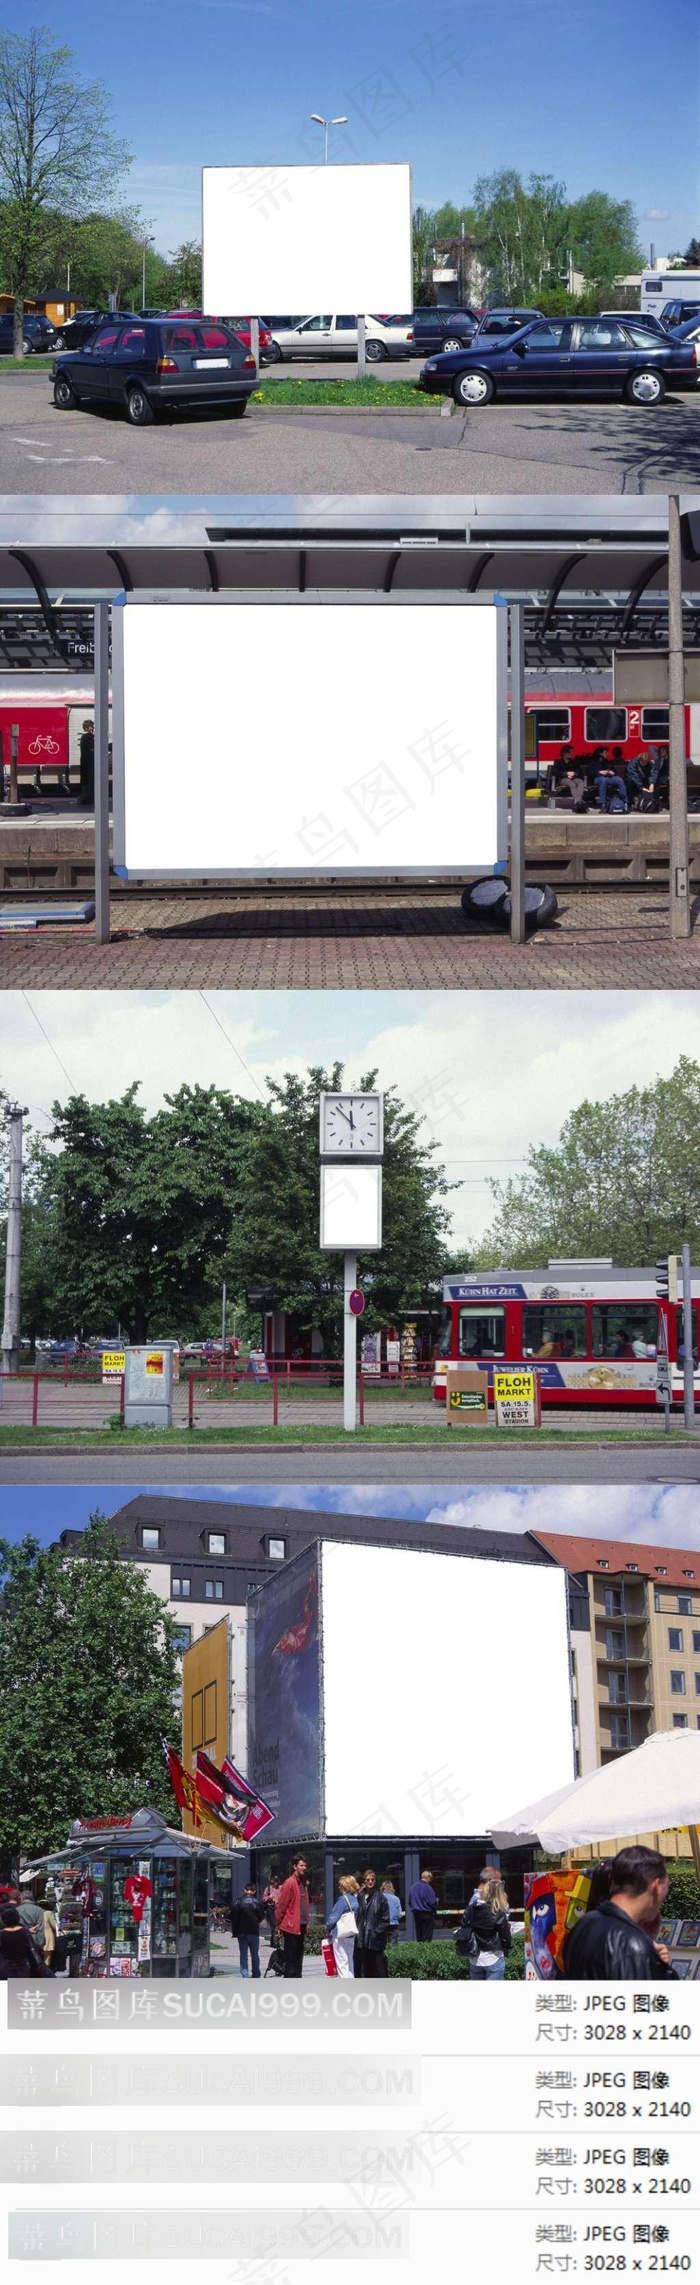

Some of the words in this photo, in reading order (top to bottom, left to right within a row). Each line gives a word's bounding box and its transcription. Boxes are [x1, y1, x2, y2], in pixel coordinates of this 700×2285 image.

[630, 711, 640, 725] 2
[497, 1377, 532, 1387] FLOH
[497, 1388, 532, 1396] MARKT
